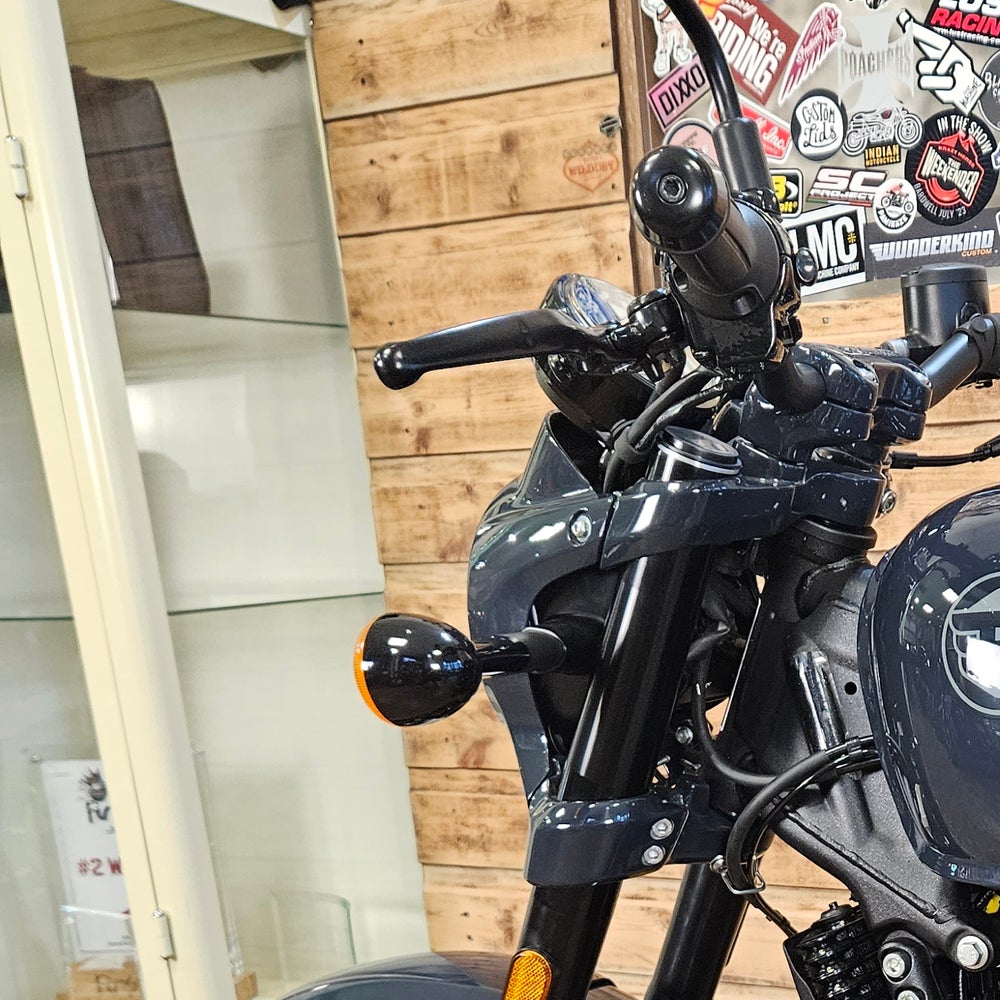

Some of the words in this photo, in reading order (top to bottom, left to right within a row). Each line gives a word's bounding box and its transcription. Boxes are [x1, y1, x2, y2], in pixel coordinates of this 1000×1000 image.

[749, 13, 786, 60] We're
[803, 120, 838, 148] Lids
[937, 116, 949, 135] IN
[950, 114, 970, 133] THE
[968, 121, 994, 154] SHOW
[865, 144, 899, 160] INDIAN
[812, 168, 888, 194] SC
[922, 146, 980, 201] WEEKENDER
[809, 188, 876, 201] PROJECT
[938, 208, 954, 219] JULY
[869, 230, 995, 261] WUNDERKIND
[961, 248, 993, 258] CUSTOM
[835, 261, 860, 275] COMPANY
